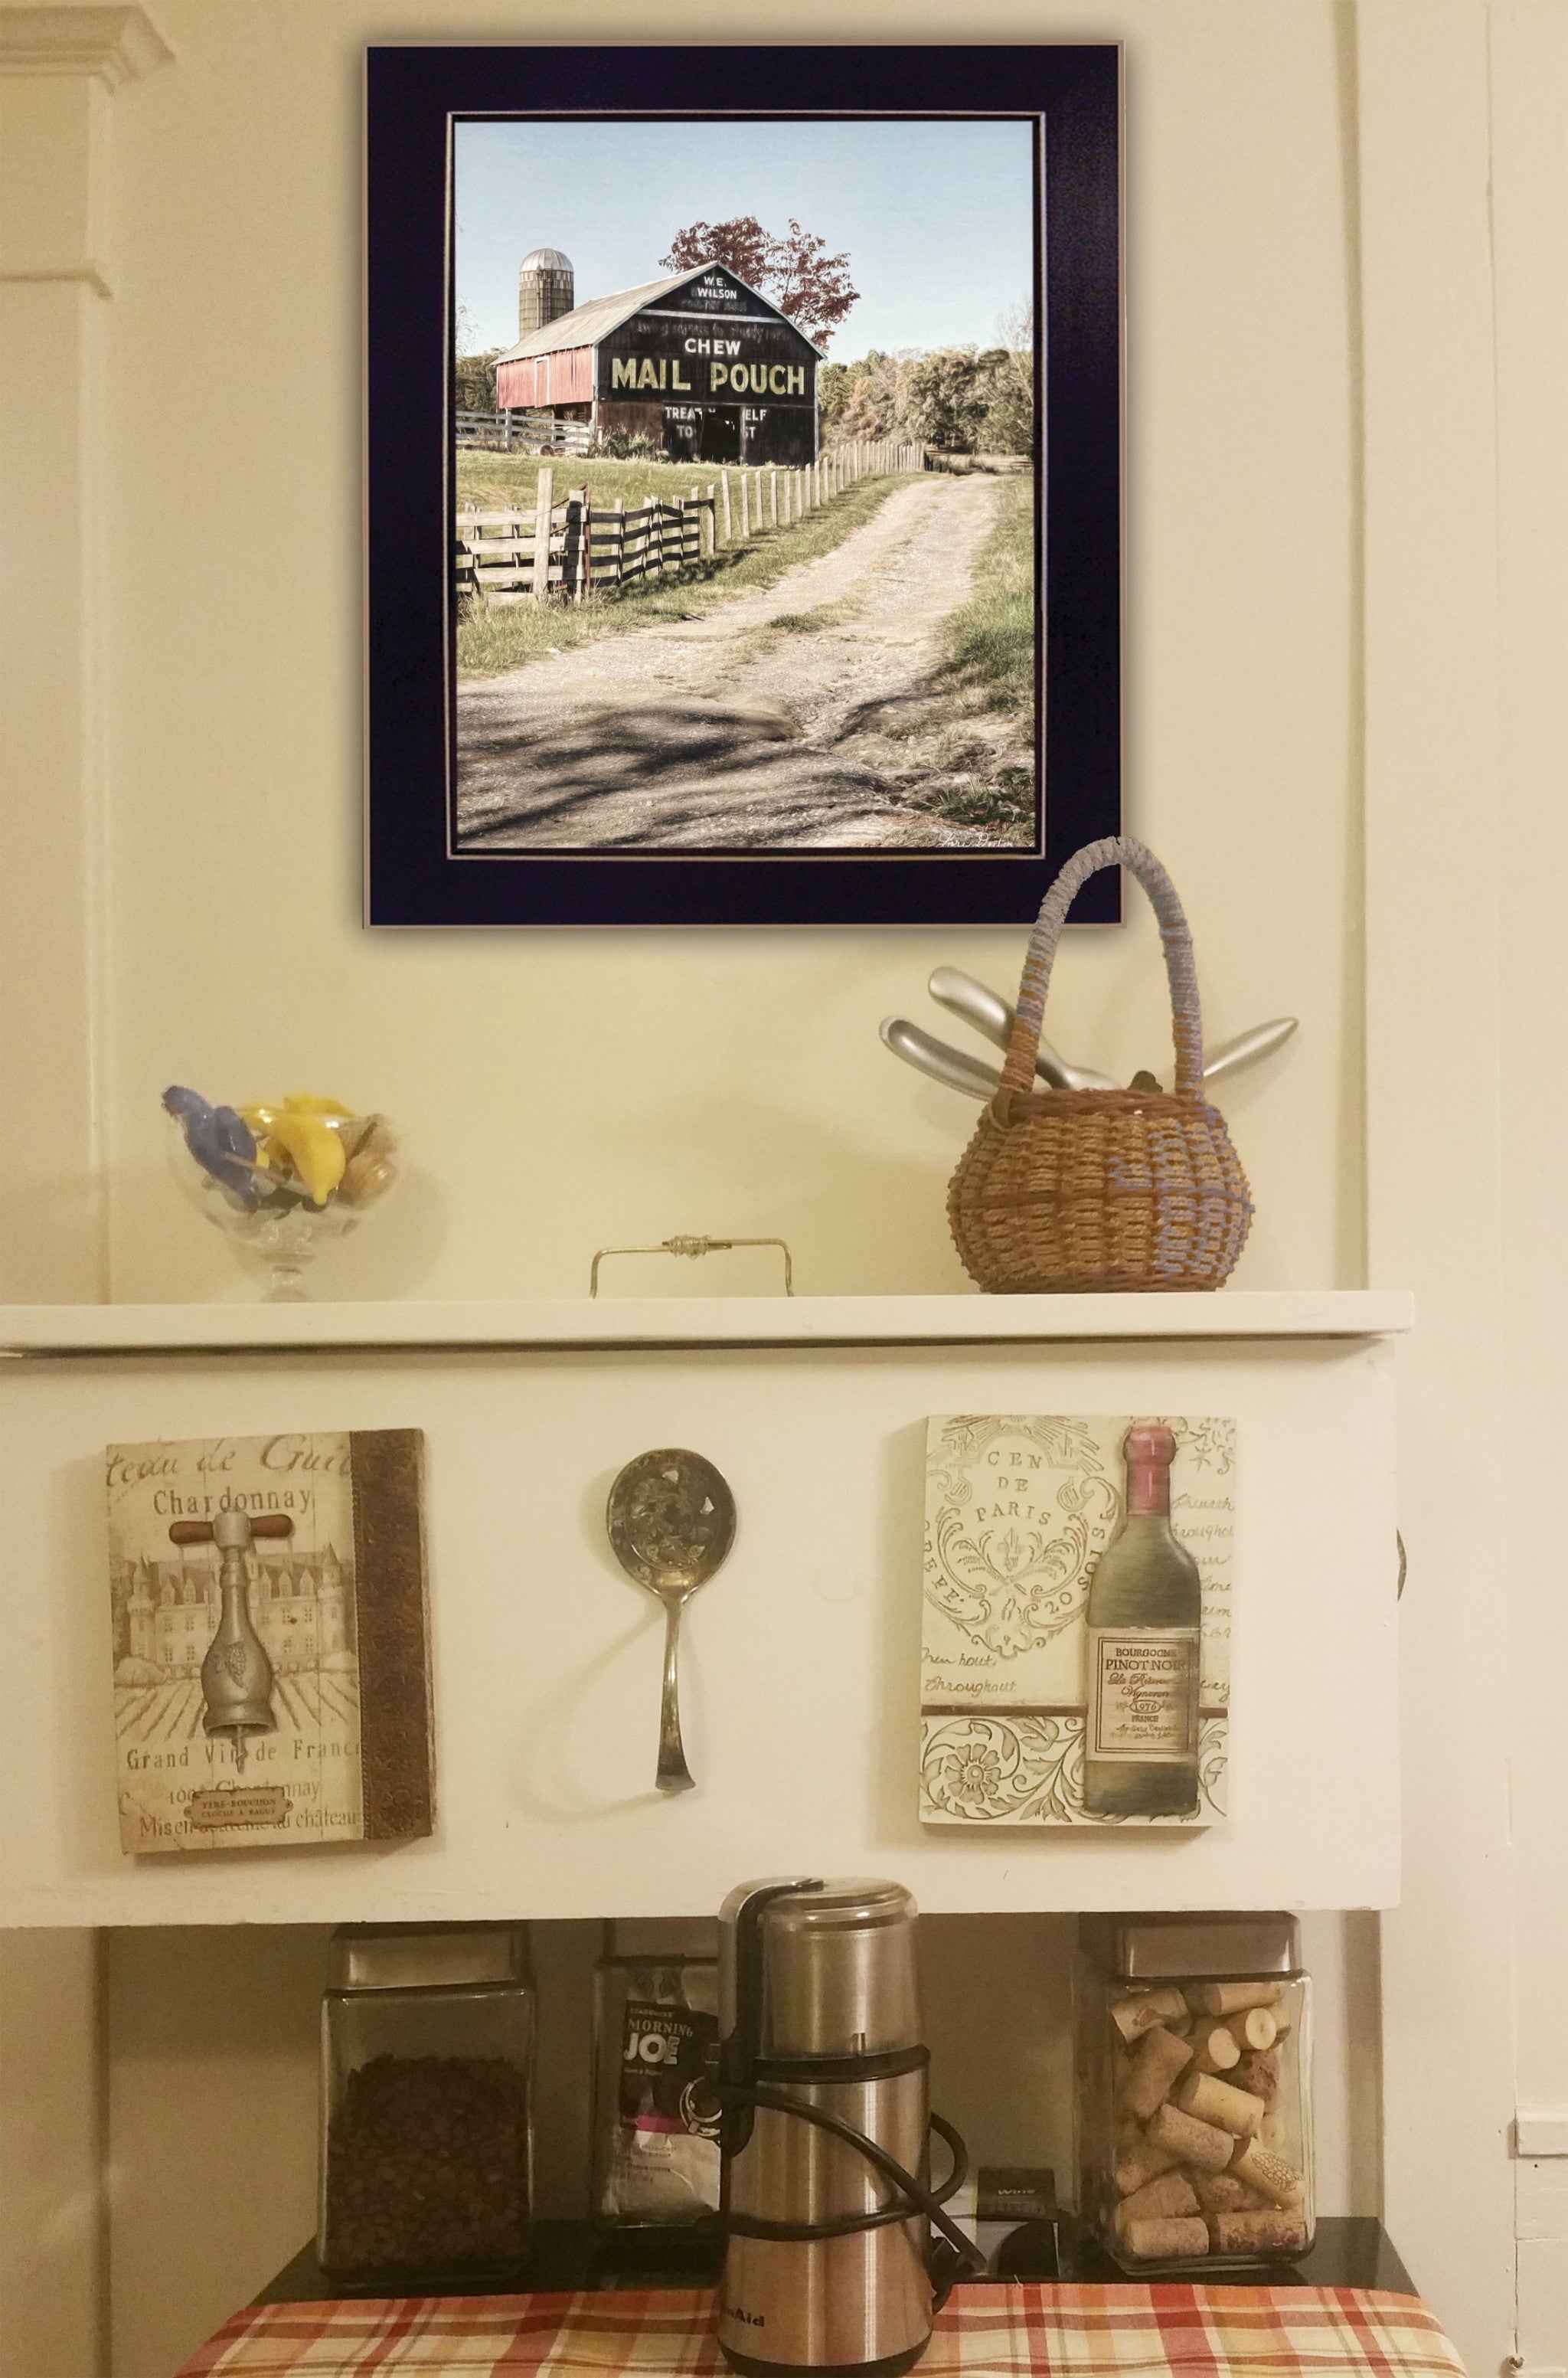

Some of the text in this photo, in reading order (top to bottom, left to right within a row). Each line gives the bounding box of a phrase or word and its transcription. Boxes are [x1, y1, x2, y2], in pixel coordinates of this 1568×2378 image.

[697, 287, 737, 300] WILSON
[684, 338, 741, 356] CHEW
[612, 357, 805, 395] MAIL POUCH
[998, 1476, 1029, 1493] DE
[152, 1486, 311, 1516] Chardonnay
[975, 1501, 1052, 1526] PARIS
[1106, 1658, 1187, 1672] PINOT NOIR
[1131, 1715, 1159, 1723] FRANCE
[126, 1745, 190, 1771] Grand
[254, 1740, 277, 1761] de
[628, 2018, 694, 2037] MORNING
[623, 2031, 681, 2066] JOE
